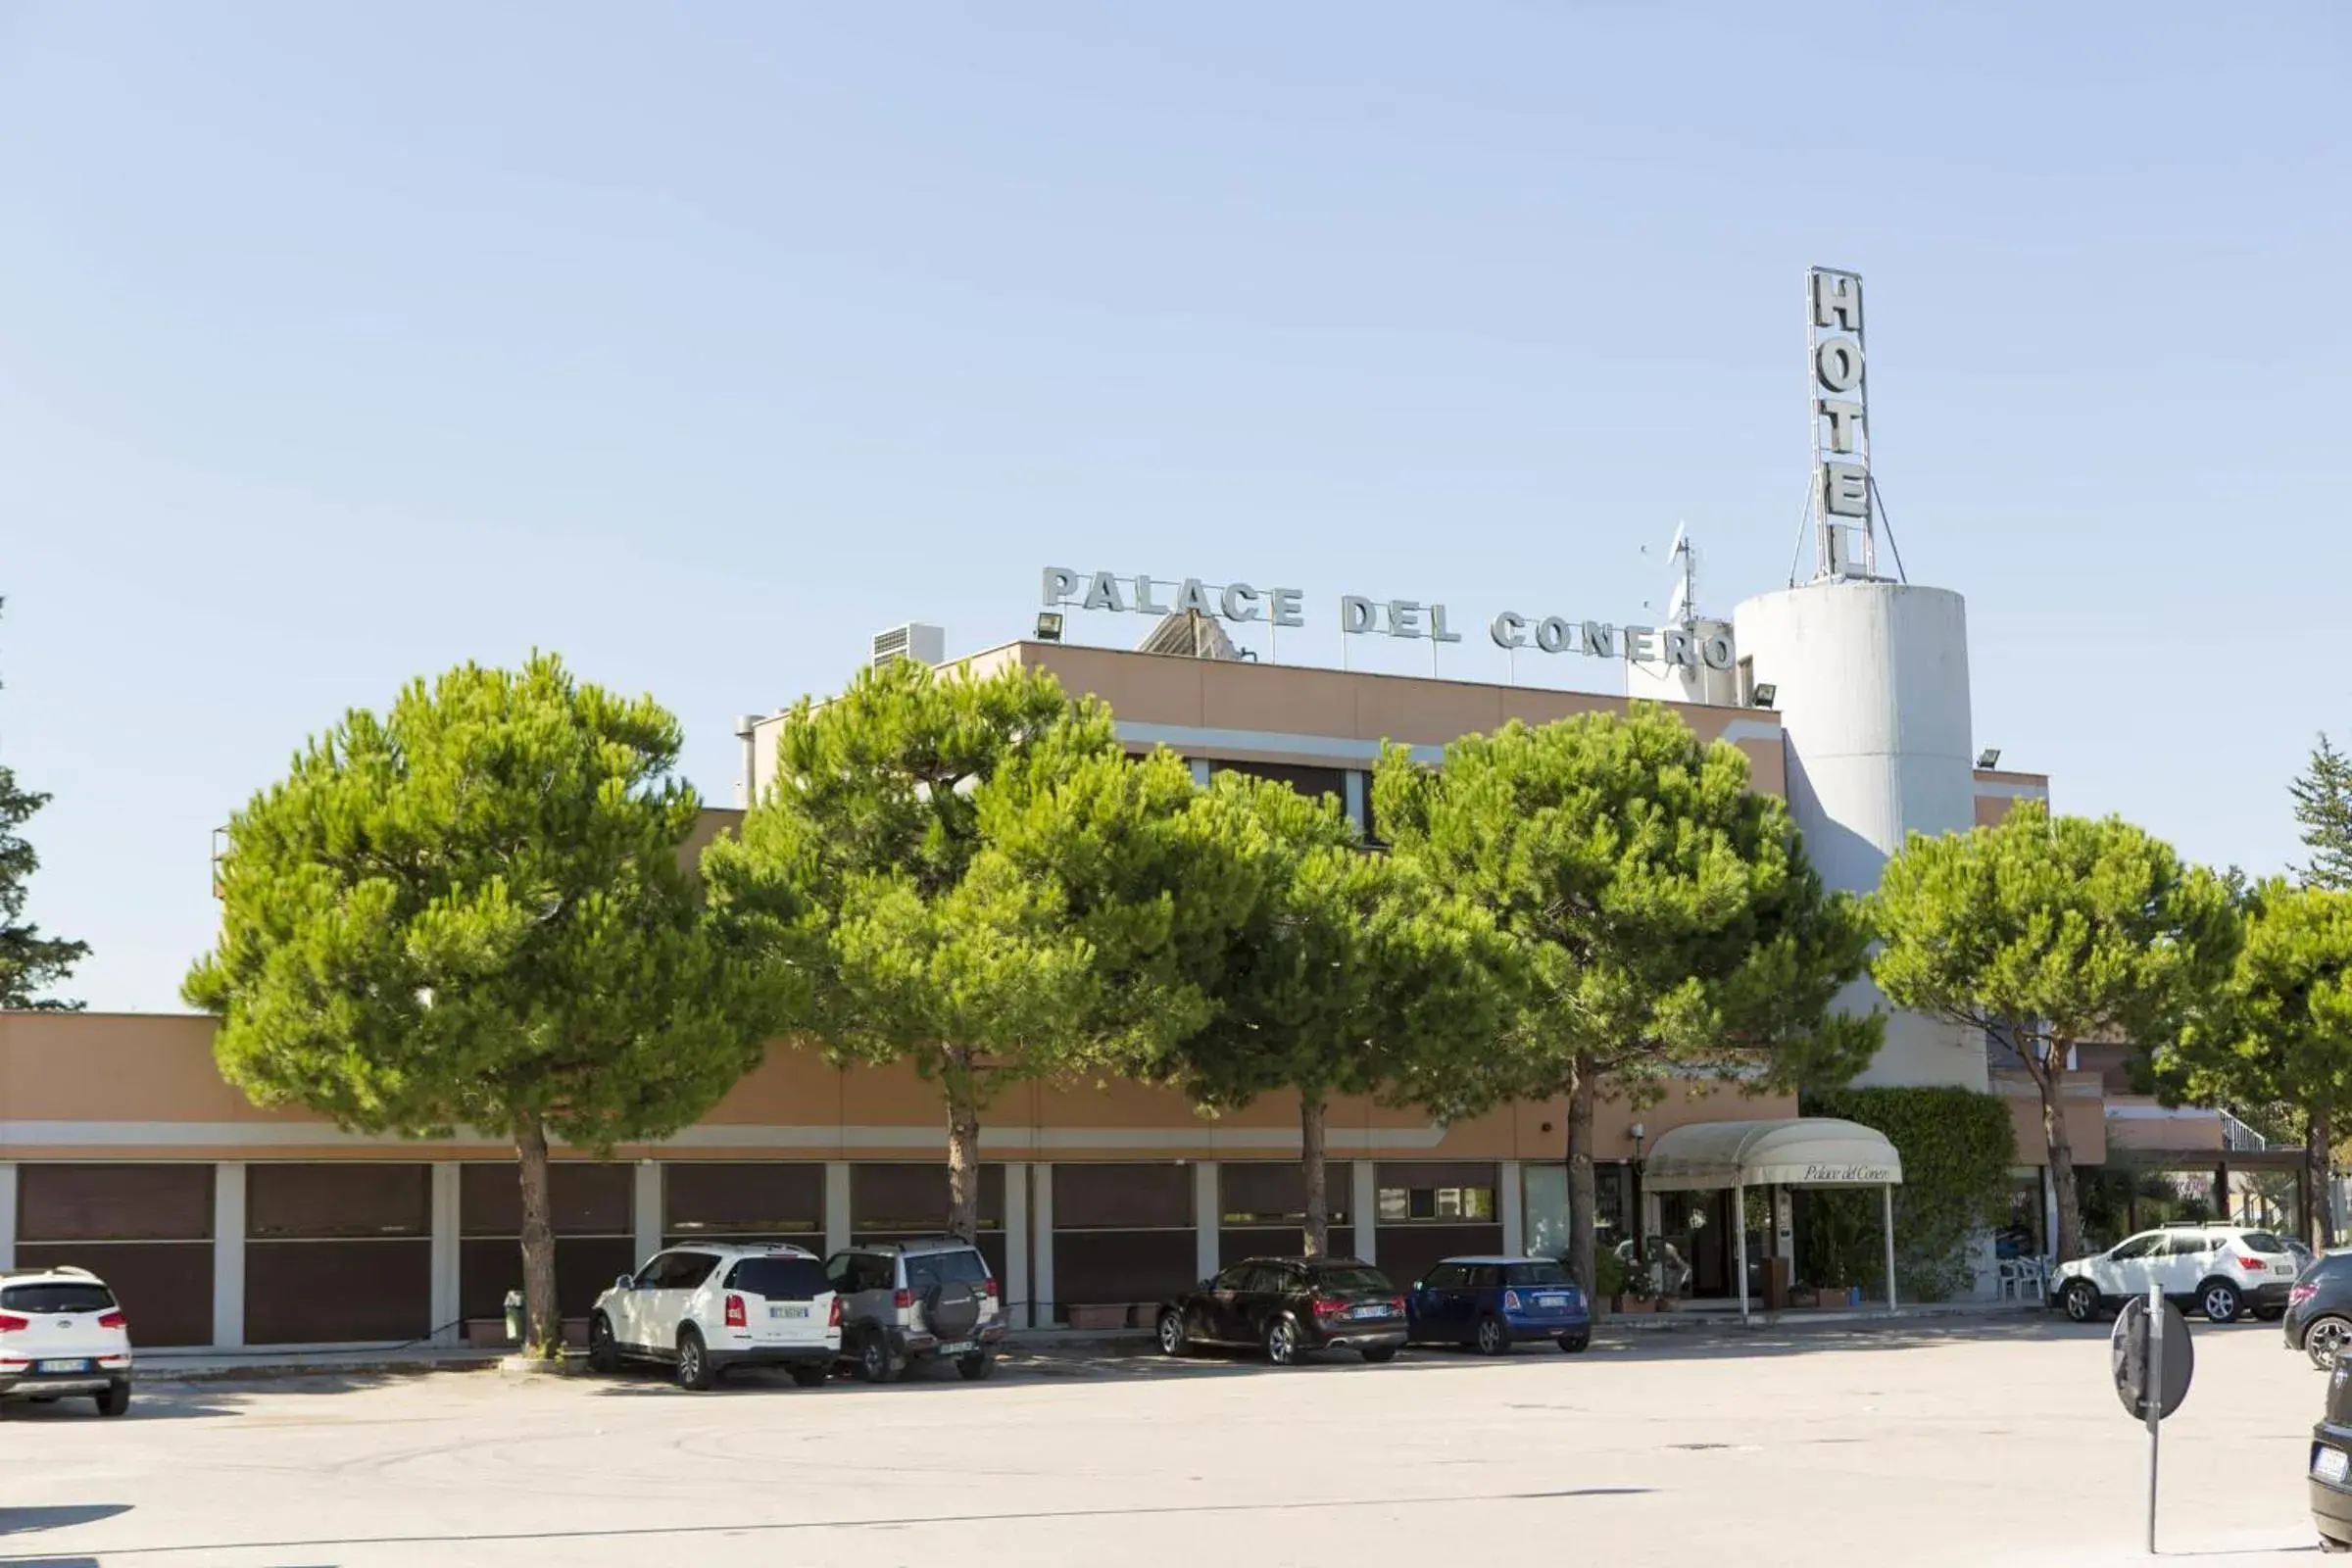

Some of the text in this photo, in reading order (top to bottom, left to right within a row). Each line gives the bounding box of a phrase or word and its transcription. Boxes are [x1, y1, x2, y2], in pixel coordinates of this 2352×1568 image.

[1814, 272, 1870, 578] HOTEL
[1042, 566, 1736, 670] PALACE DEL CONERO
